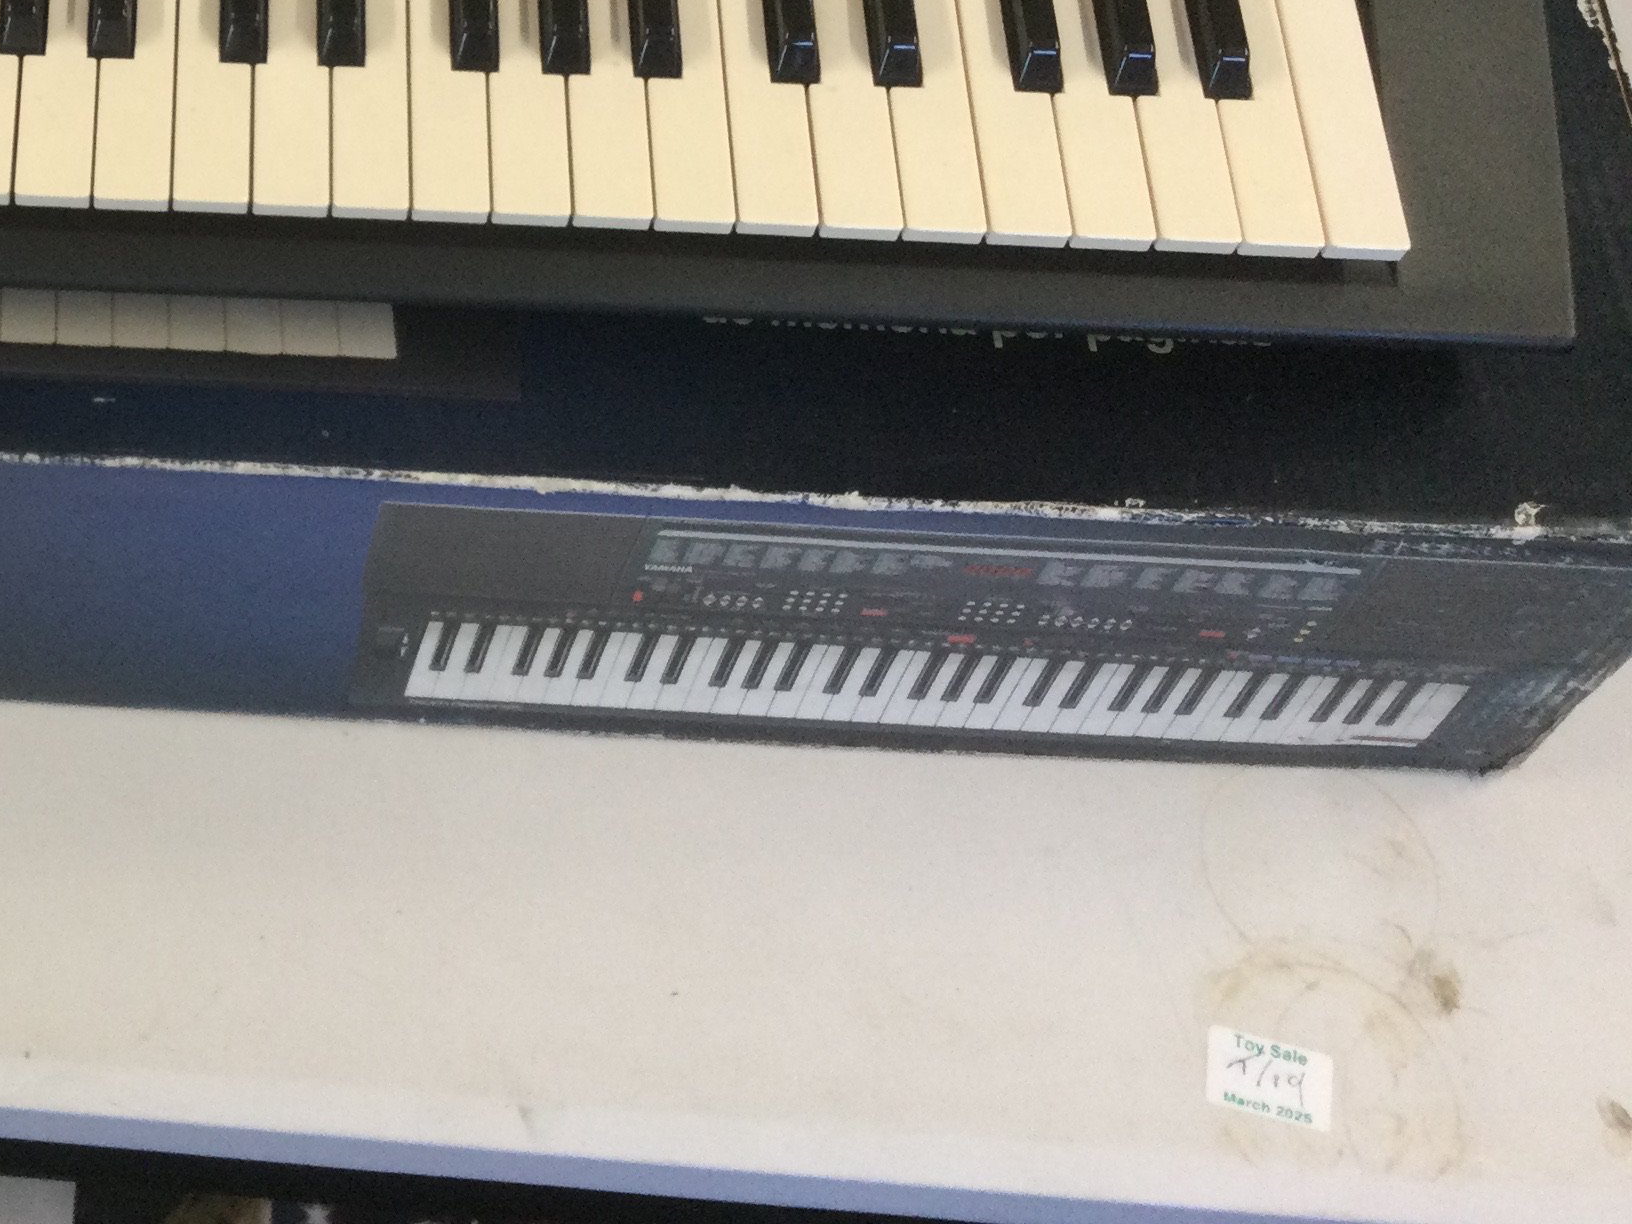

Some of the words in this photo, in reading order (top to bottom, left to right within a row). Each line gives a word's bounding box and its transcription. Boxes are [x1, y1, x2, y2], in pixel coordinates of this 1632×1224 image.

[643, 562, 694, 574] YAMAHA
[1234, 1033, 1265, 1057] Toy
[1270, 1044, 1308, 1066] Sale
[1223, 1091, 1270, 1113] March
[1276, 1106, 1313, 1124] 2025
